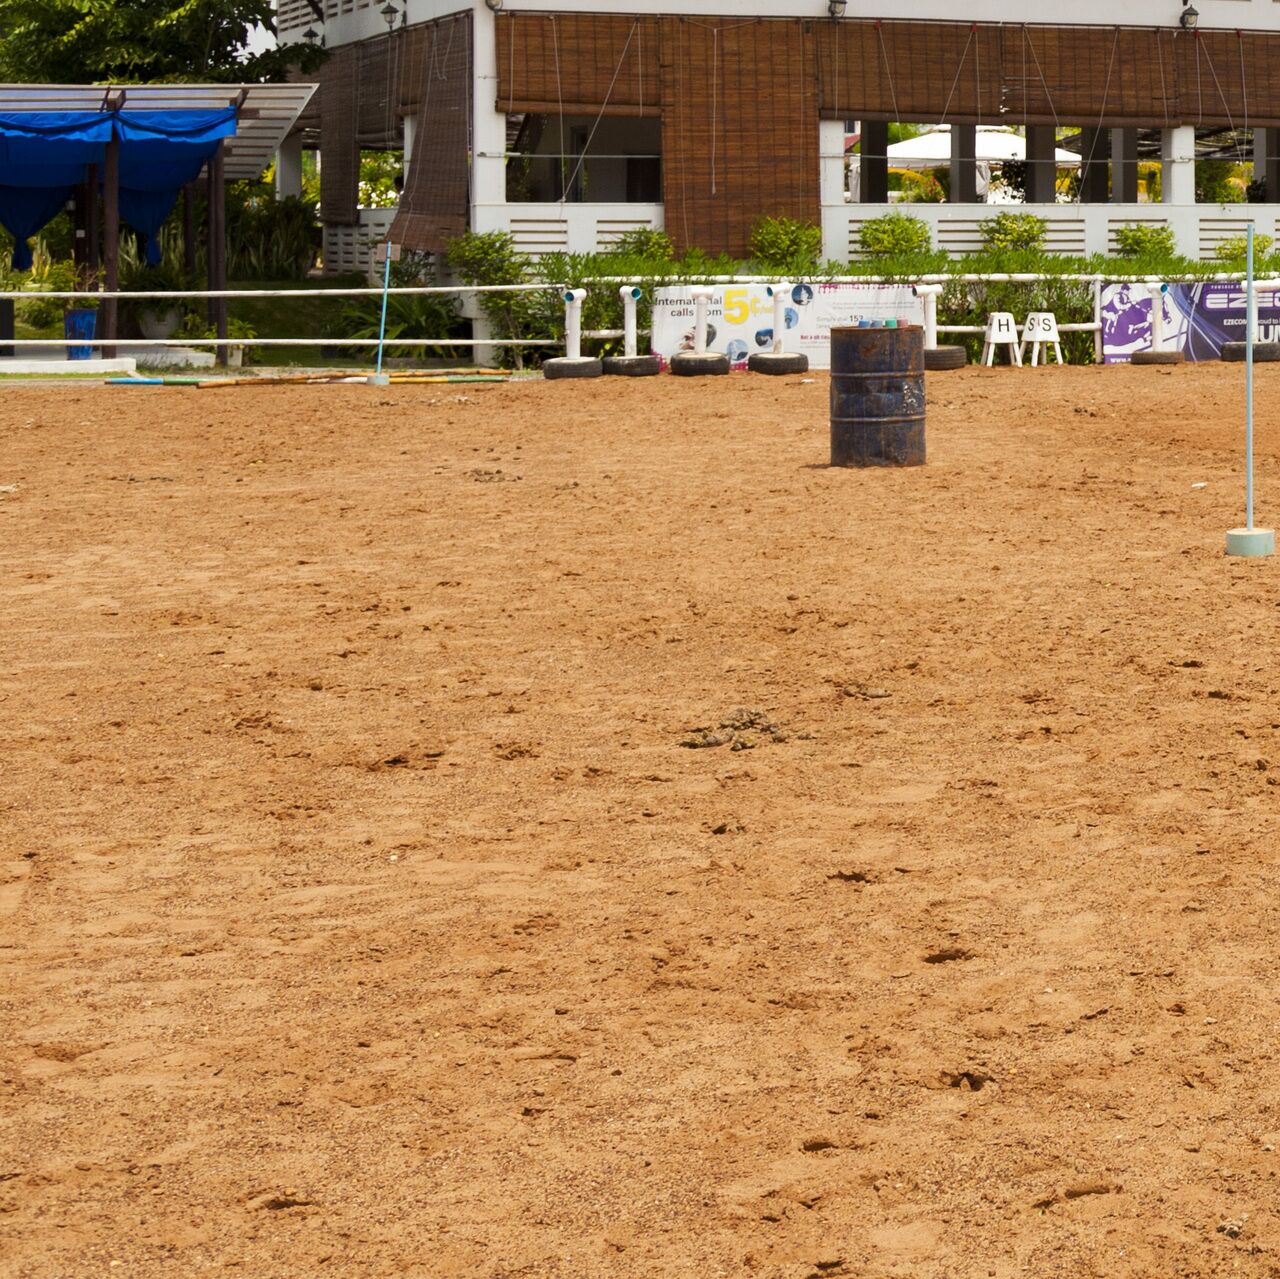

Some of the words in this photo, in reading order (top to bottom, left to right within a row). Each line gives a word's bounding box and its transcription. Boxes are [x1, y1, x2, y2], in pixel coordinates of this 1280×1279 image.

[670, 308, 694, 317] calls
[998, 318, 1010, 332] H
[1028, 317, 1035, 331] S
[1042, 318, 1052, 331] S
